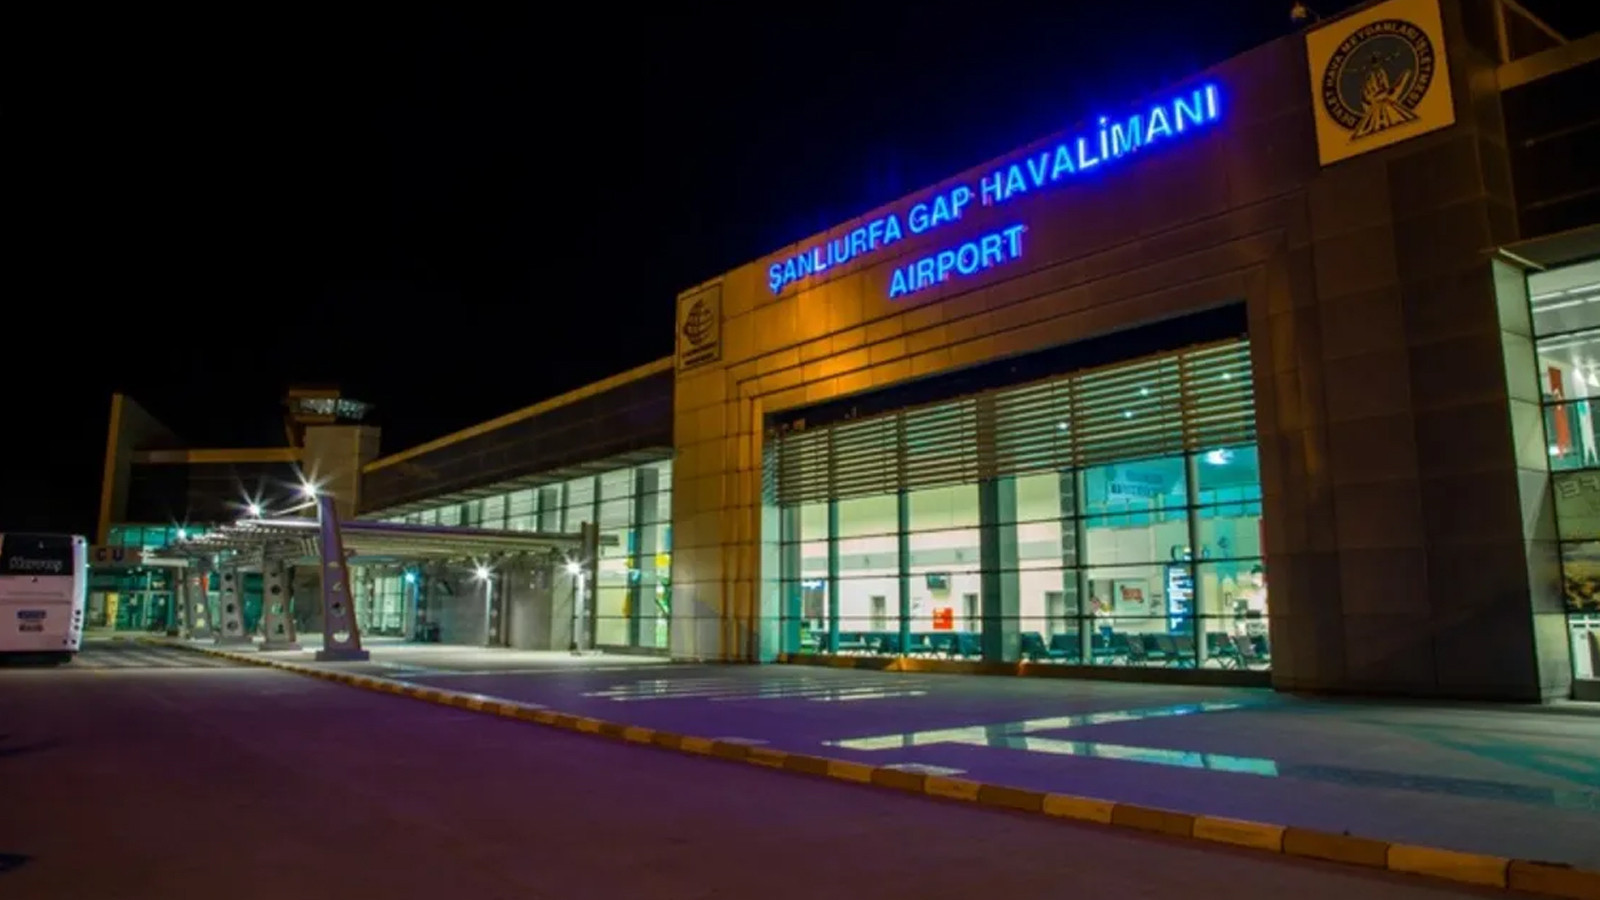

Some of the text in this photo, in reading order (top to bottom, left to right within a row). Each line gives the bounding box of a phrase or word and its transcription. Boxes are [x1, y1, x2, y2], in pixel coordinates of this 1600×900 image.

[769, 84, 1217, 294] ŞANLIURFA GAP HAVALİMANI
[889, 224, 1025, 298] AIRPORT
